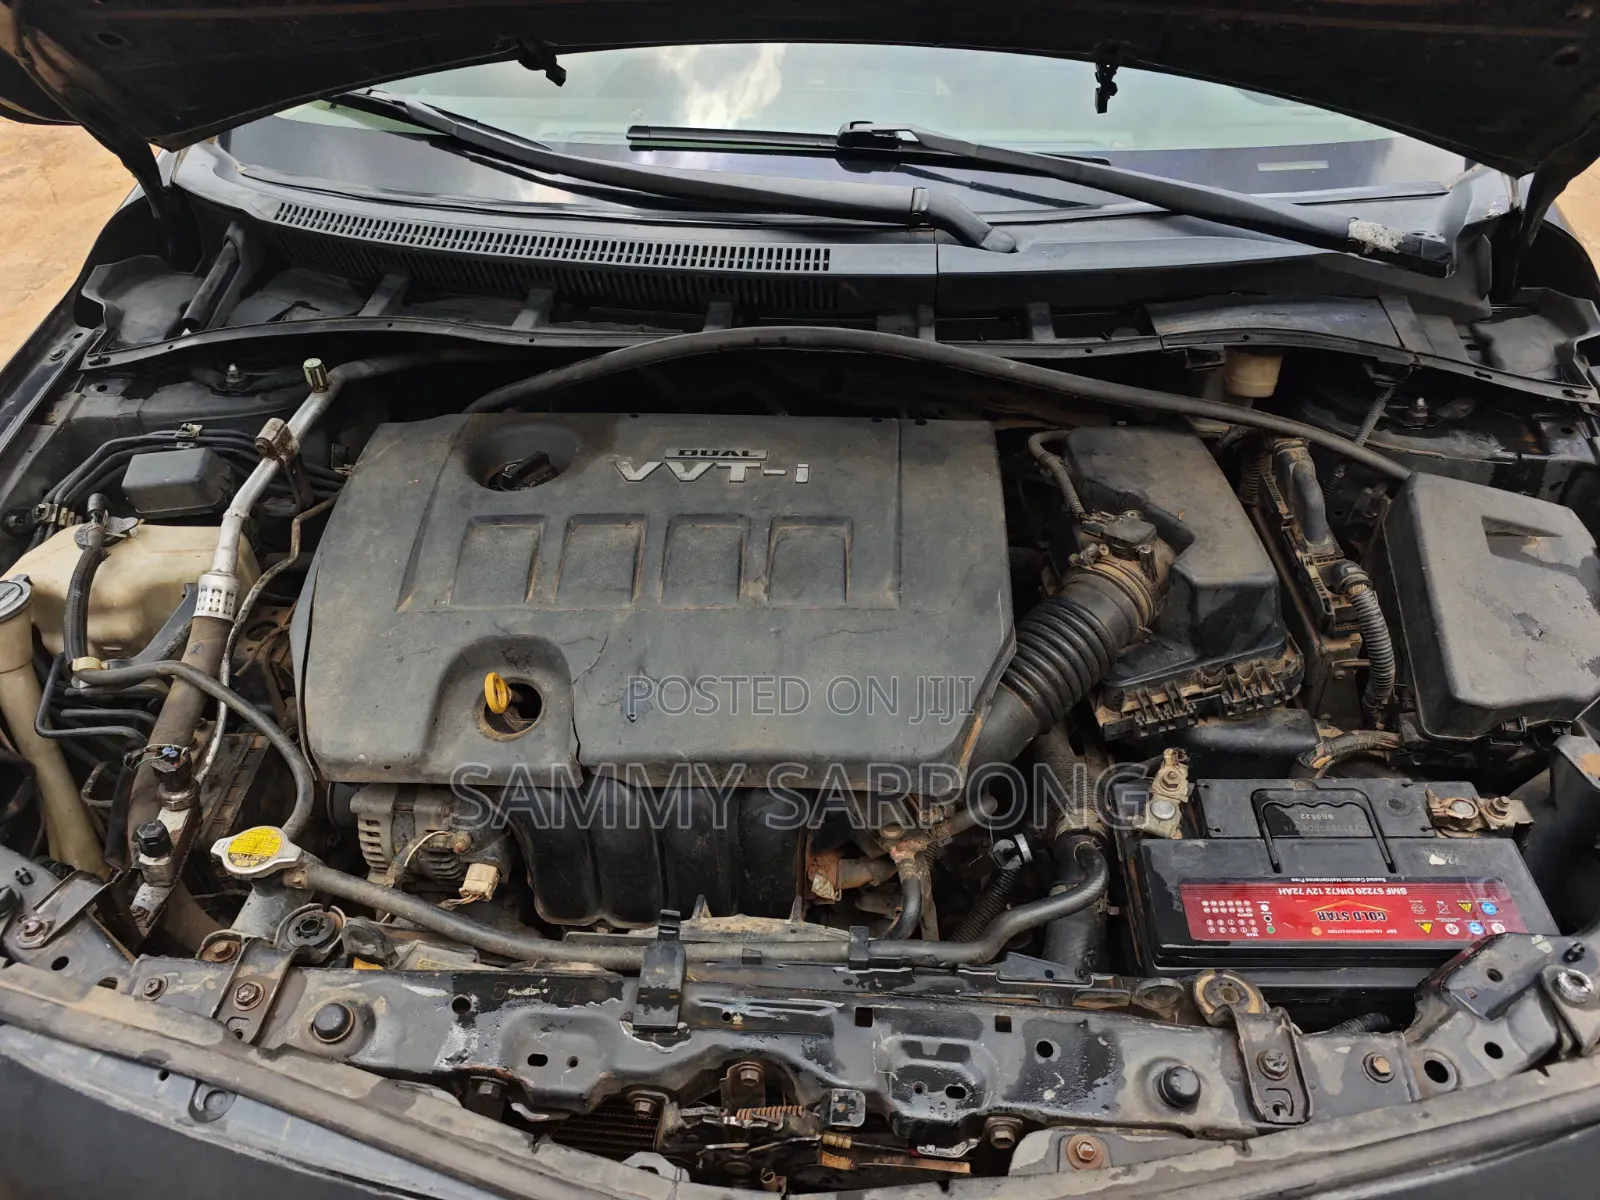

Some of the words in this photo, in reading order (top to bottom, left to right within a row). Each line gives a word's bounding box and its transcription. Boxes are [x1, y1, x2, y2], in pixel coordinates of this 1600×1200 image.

[678, 449, 759, 457] DUAL
[613, 461, 810, 484] VVT-i
[230, 852, 268, 862] CAUTION
[1278, 887, 1305, 895] 72AH
[1306, 887, 1324, 895] 12V
[1326, 887, 1355, 895] DIN72
[1356, 887, 1385, 895] 57220
[1386, 887, 1408, 895] SMF
[1316, 911, 1350, 922] STAR
[1353, 911, 1388, 922] GOLD
